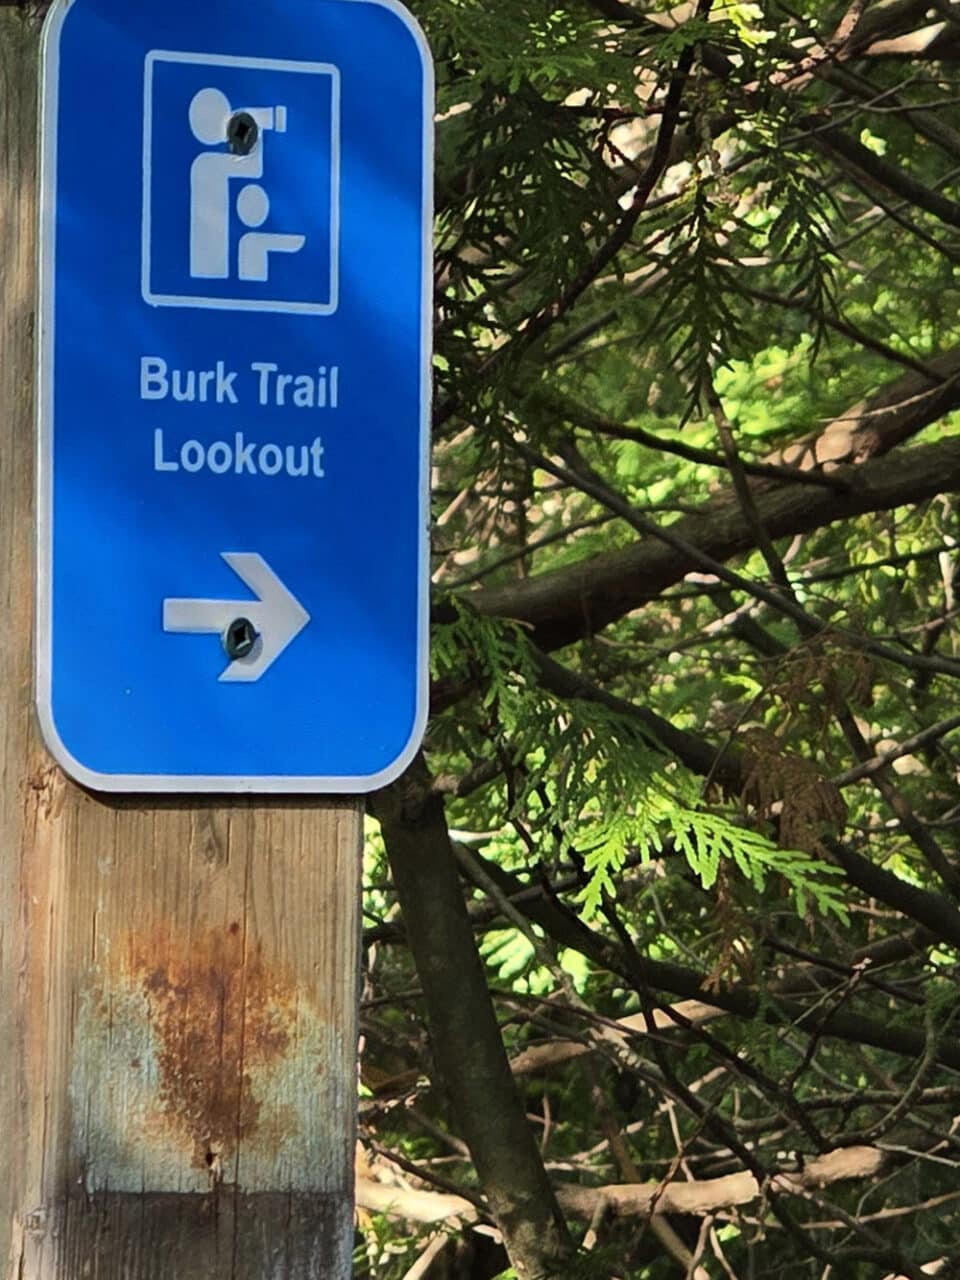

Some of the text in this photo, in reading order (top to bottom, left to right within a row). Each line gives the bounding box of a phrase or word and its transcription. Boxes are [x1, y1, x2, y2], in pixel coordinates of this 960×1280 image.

[140, 356, 339, 408] Burk Trail
[154, 428, 325, 477] Lookout
